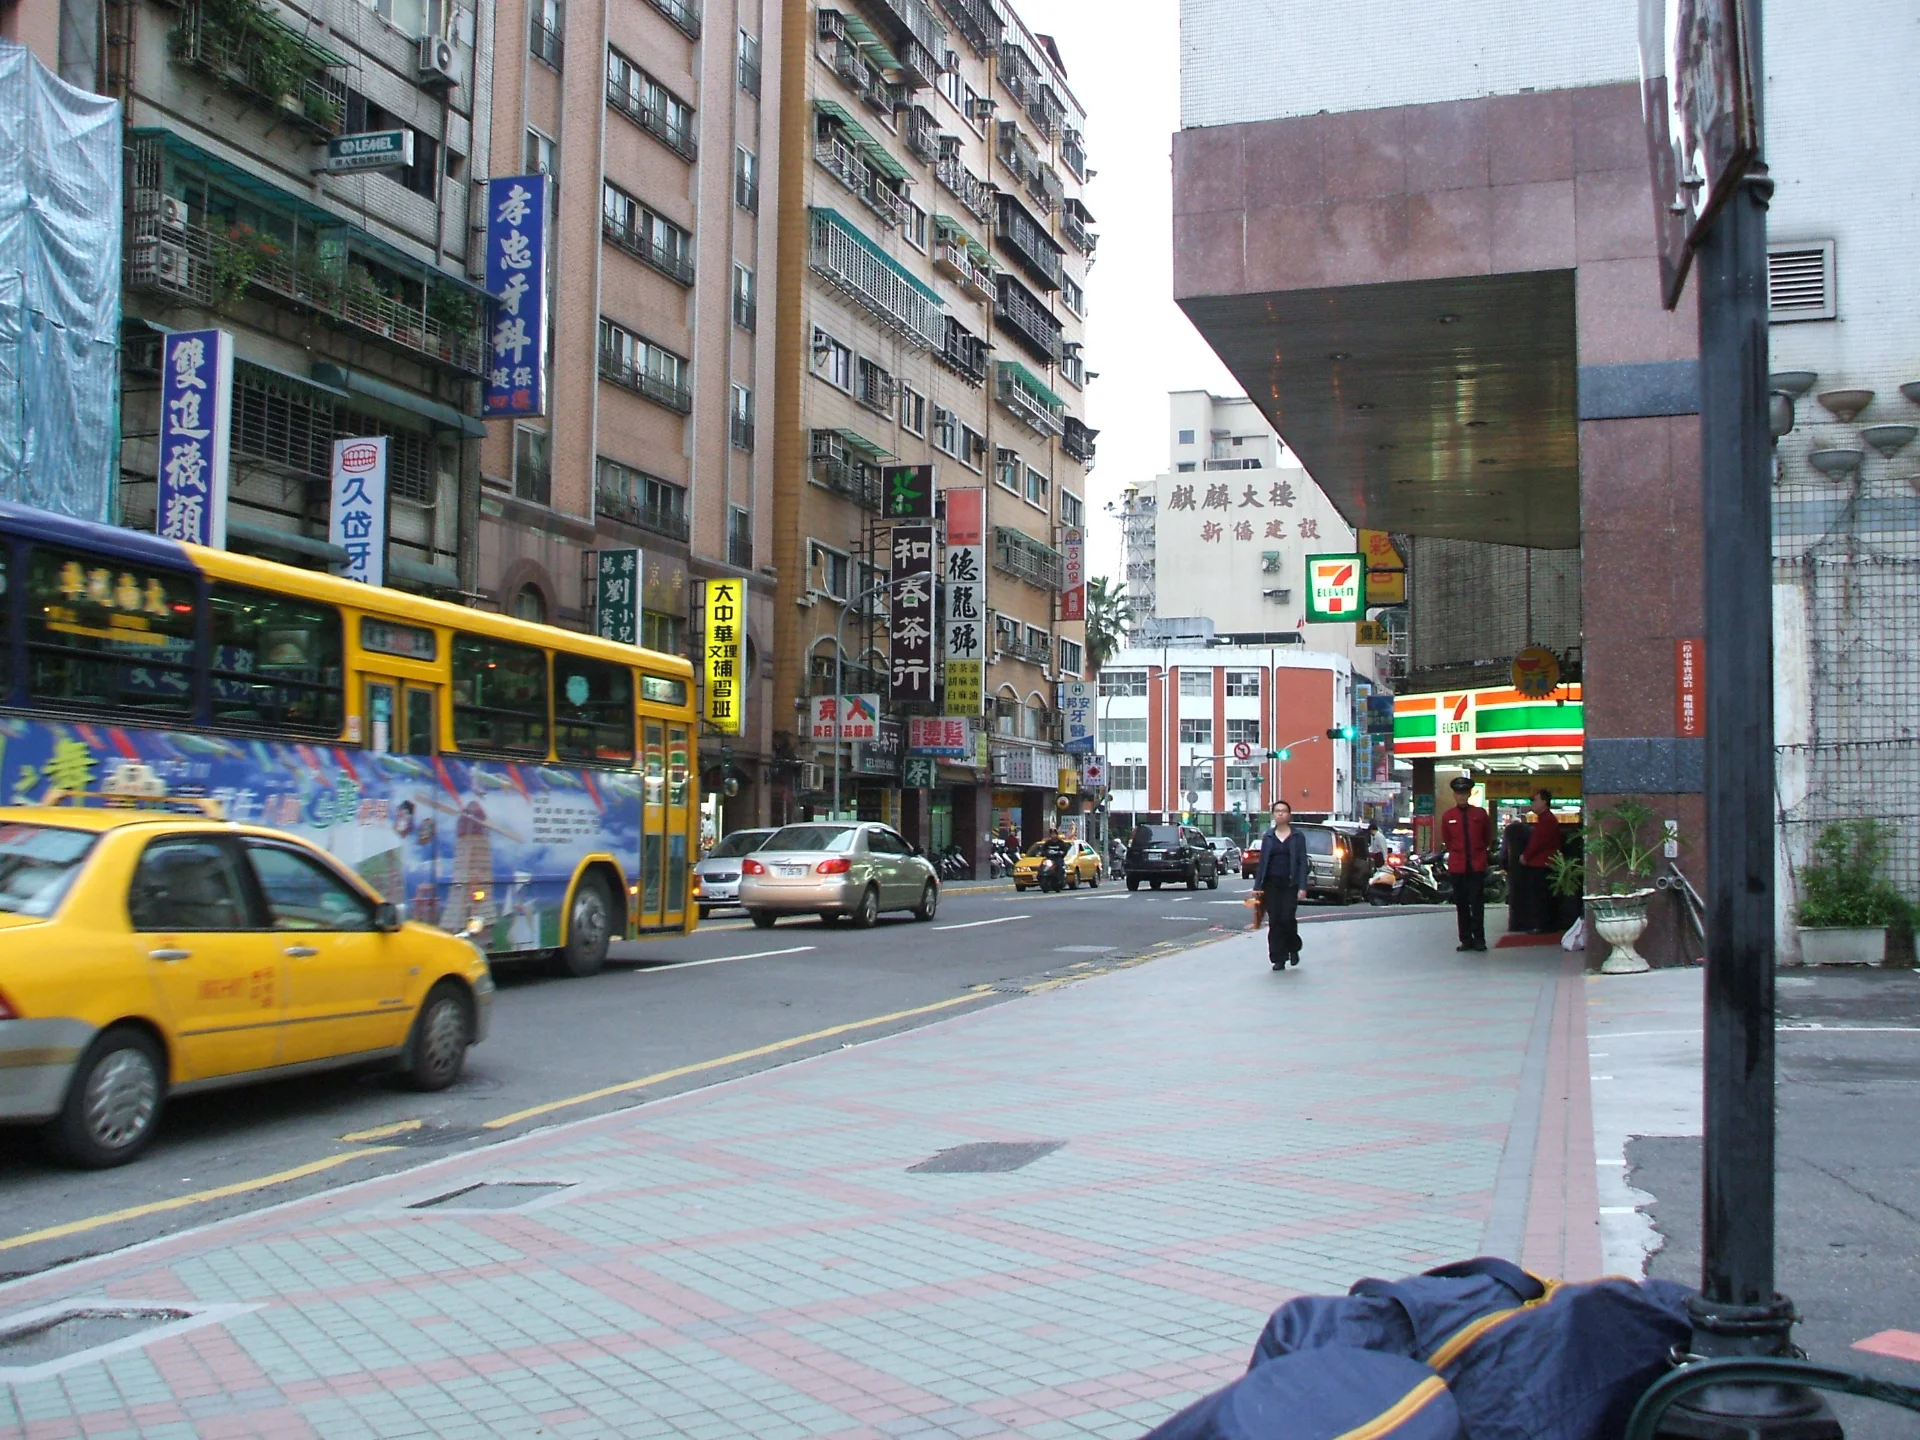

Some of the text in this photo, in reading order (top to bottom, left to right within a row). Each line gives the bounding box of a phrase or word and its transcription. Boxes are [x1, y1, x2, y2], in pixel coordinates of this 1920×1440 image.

[355, 137, 393, 152] LEMEL
[493, 184, 533, 364] 孝忠牙科
[491, 366, 532, 389] 健保
[1168, 481, 1297, 512] 麒麟大樓
[340, 477, 373, 584] 久岱牙
[1200, 517, 1321, 543] 新僑建設
[605, 578, 630, 604] 劉
[949, 548, 979, 657] 德龍號
[892, 538, 930, 691] 和春茶行
[819, 697, 868, 721] 亮人
[906, 760, 929, 786] 茶
